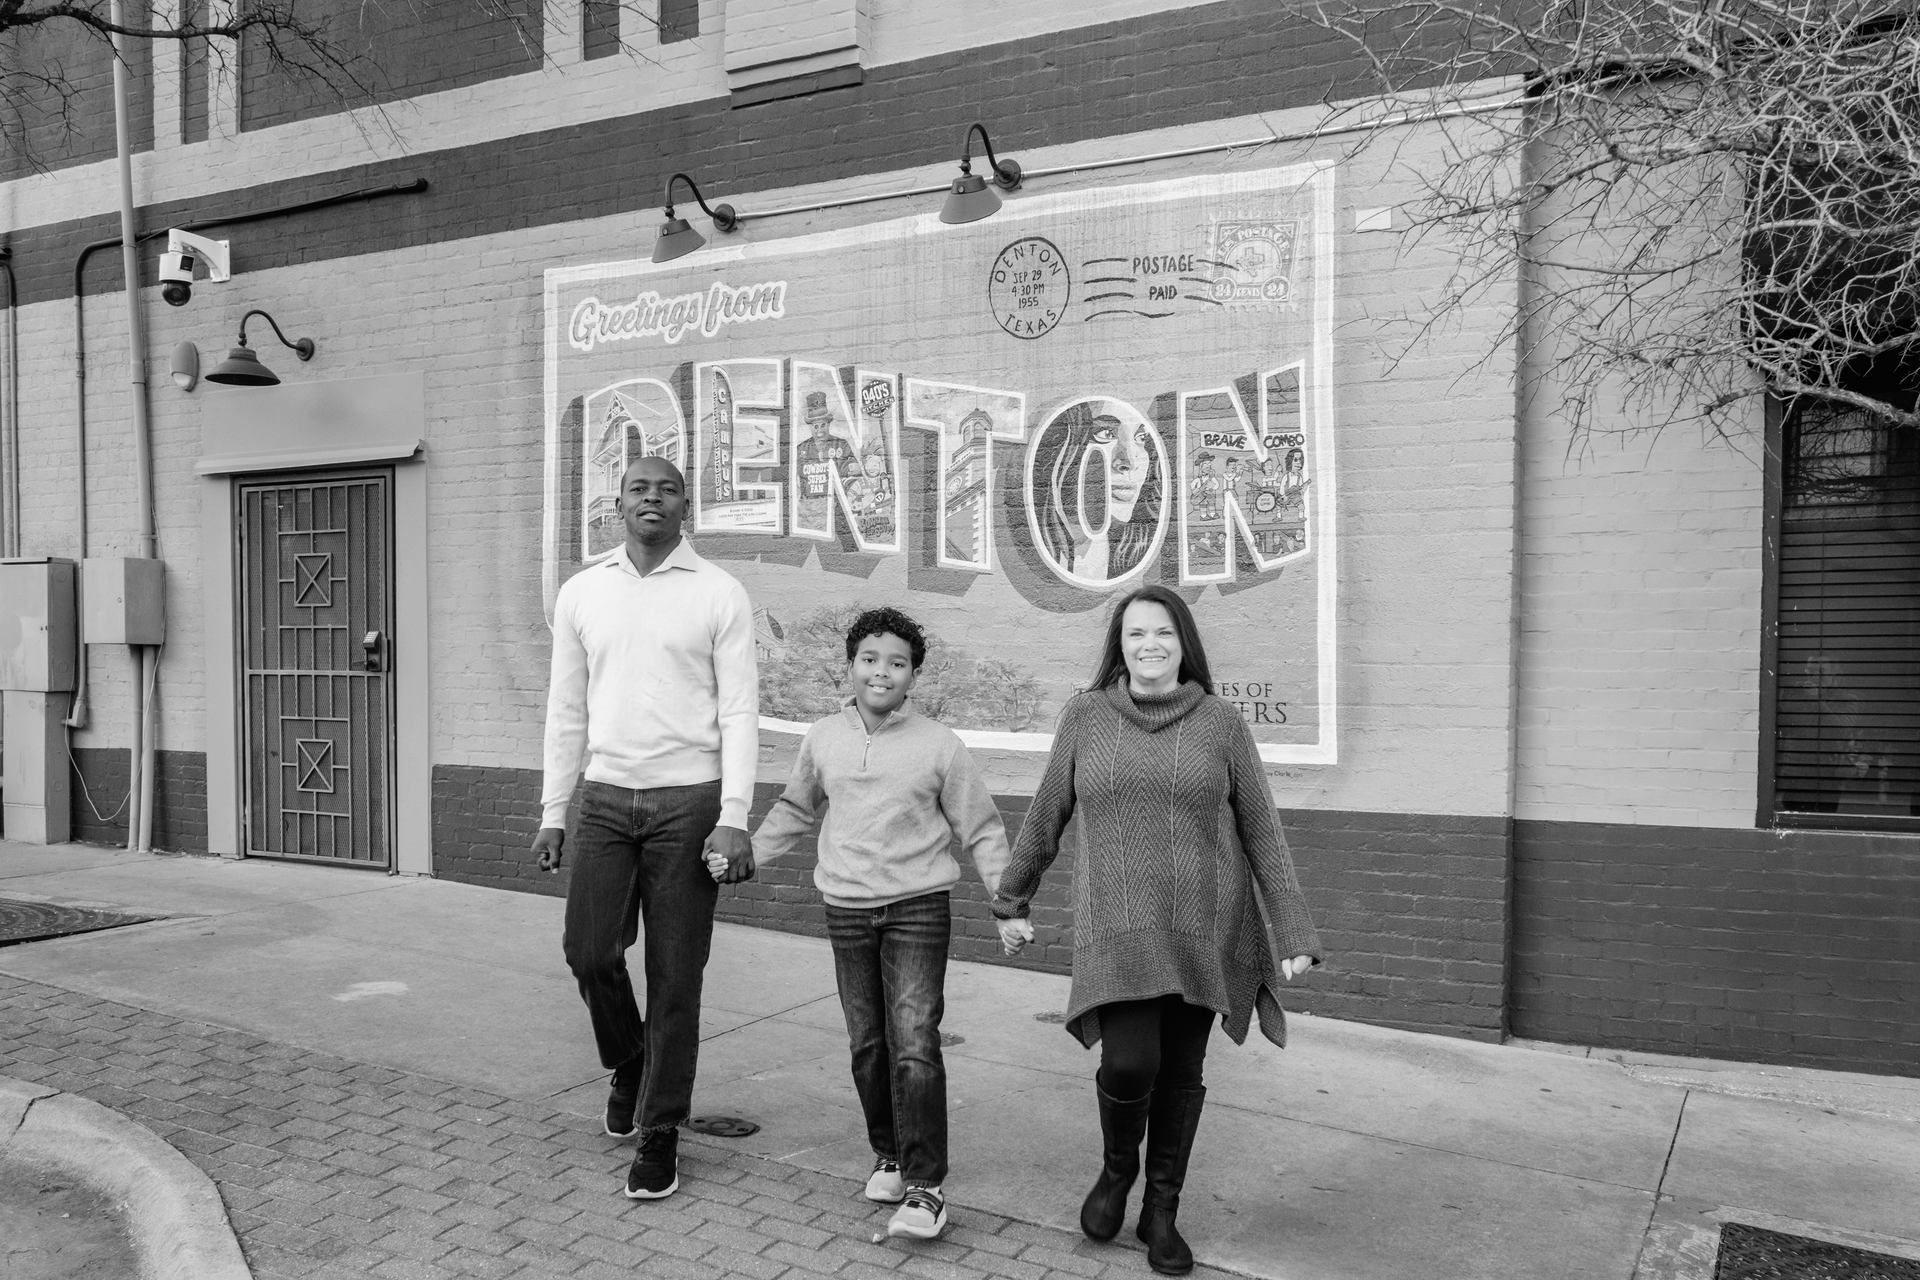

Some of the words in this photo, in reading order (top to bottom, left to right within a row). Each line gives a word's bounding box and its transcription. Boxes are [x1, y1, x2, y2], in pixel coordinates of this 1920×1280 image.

[1237, 226, 1290, 252] POSTAGE
[994, 243, 1062, 283] DENTON
[1132, 254, 1194, 274] POSTAGE
[1013, 271, 1028, 284] SEP
[1031, 269, 1042, 281] 29
[1011, 284, 1031, 297] 4:30
[1033, 283, 1045, 295] PM
[1149, 285, 1178, 300] PAID
[1214, 283, 1232, 297] 24
[1266, 282, 1285, 297] 24
[1018, 296, 1039, 309] 1955
[571, 293, 701, 347] Greetings
[704, 283, 784, 335] from
[1004, 309, 1057, 335] TEXAS
[862, 382, 890, 405] 940'S
[718, 387, 731, 497] CAMPUS
[1203, 433, 1248, 450] BRAVE
[1262, 433, 1305, 449] COMBO
[583, 358, 1309, 586] DENTON
[803, 462, 830, 475] COWBOYS
[807, 473, 827, 484] SUPER
[810, 484, 824, 494] FAN
[1246, 682, 1273, 698] OF
[1231, 701, 1287, 724] ERS
